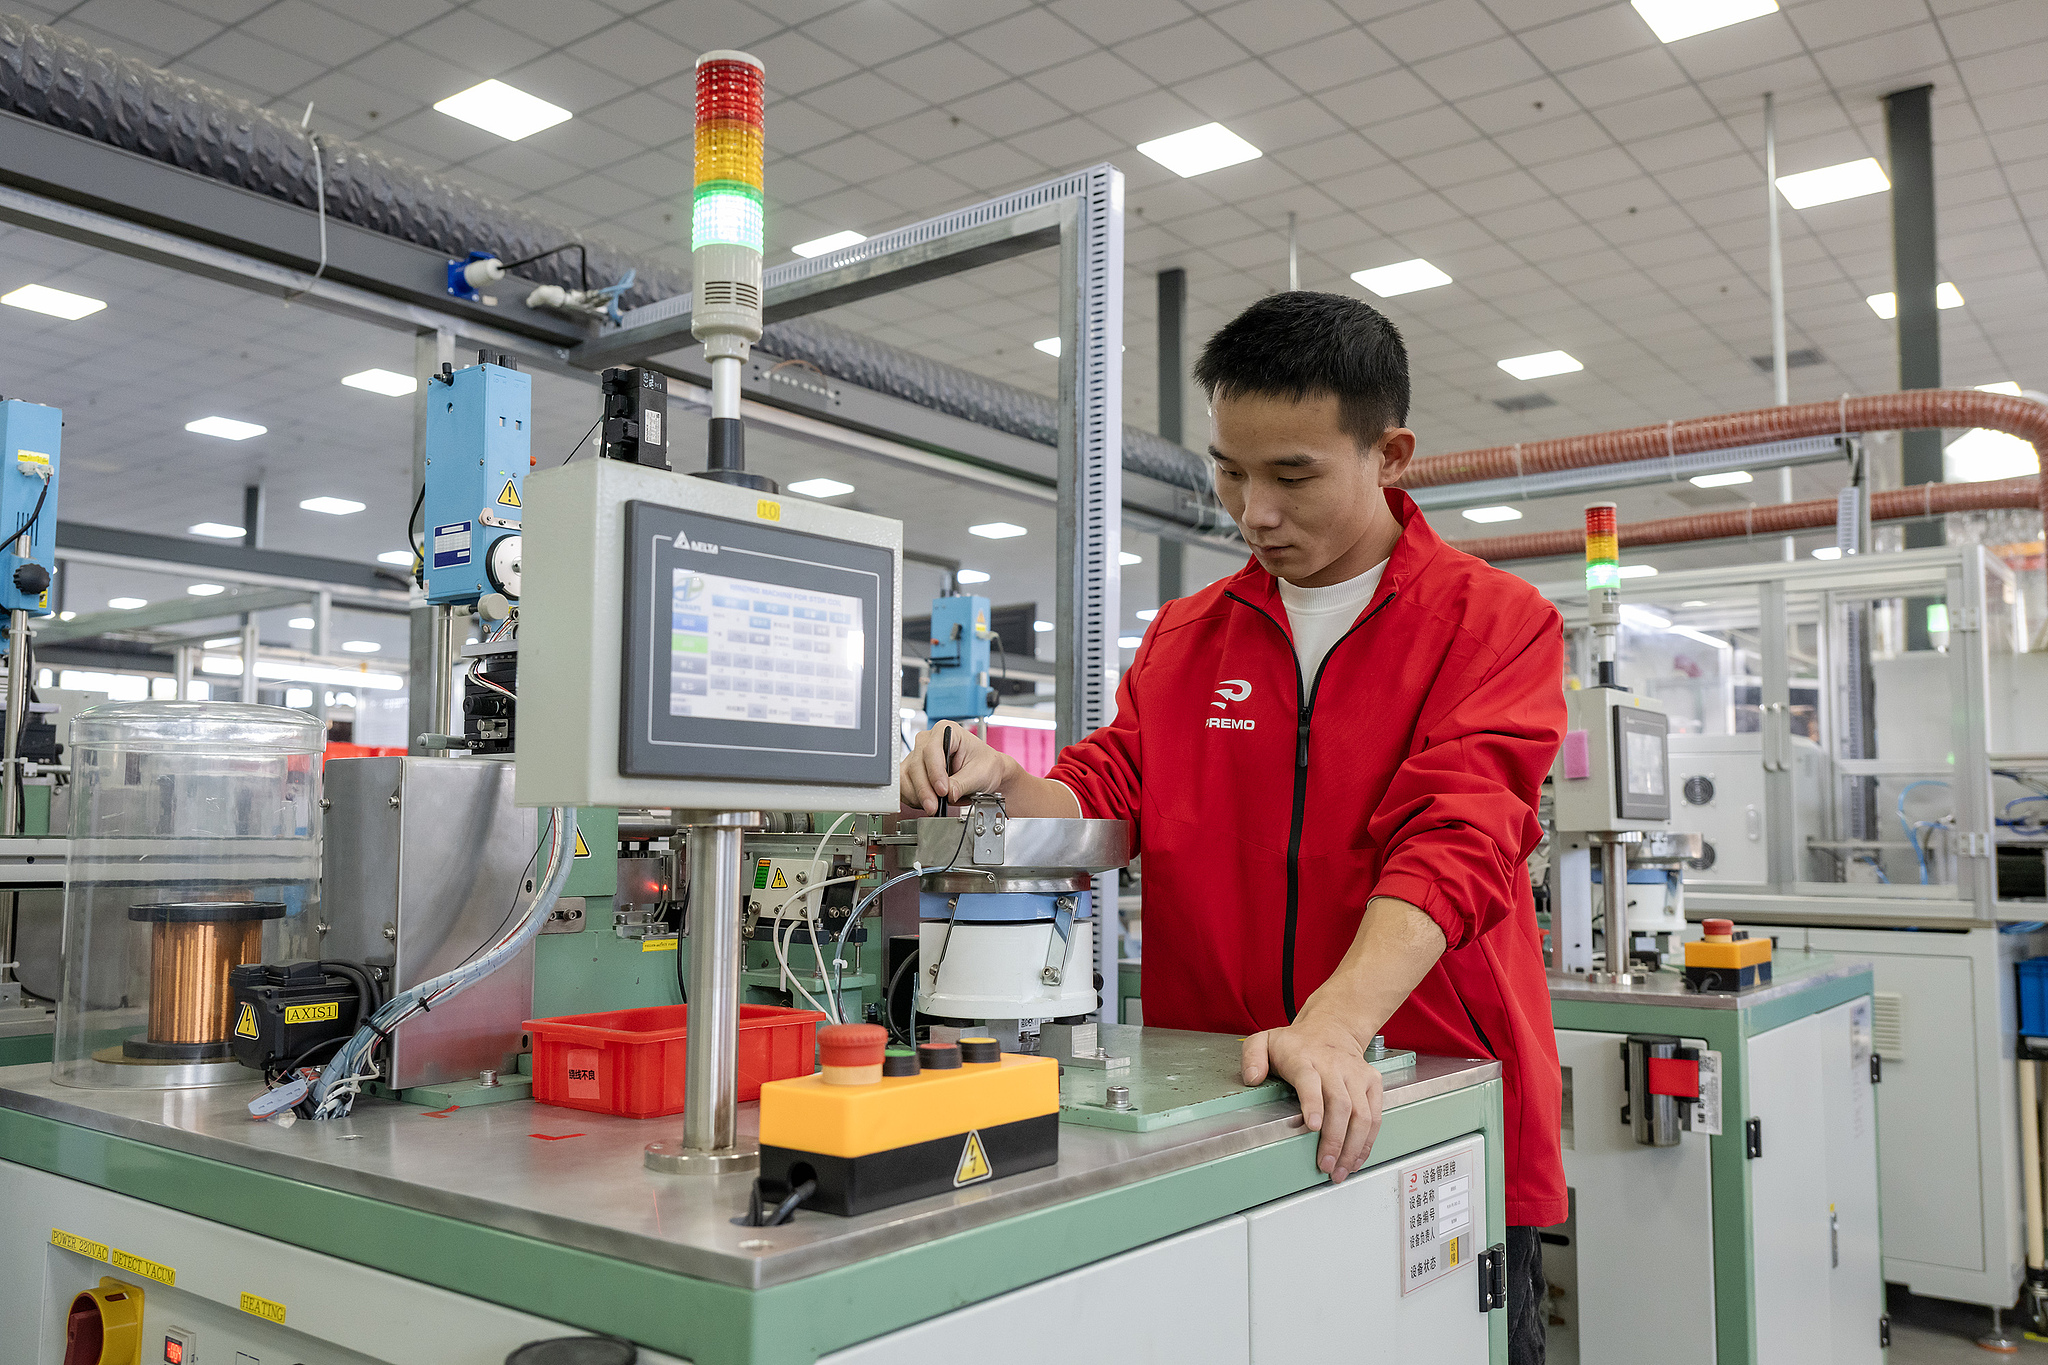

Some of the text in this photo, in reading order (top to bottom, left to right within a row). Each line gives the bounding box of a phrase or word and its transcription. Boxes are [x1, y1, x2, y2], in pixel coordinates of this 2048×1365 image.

[1205, 718, 1255, 730] REMO
[291, 1007, 332, 1020] AXIS1
[1409, 1189, 1435, 1209] 设备名称
[1409, 1208, 1435, 1229] 设备编号
[52, 1229, 109, 1262] POWER 220VAC
[1409, 1226, 1435, 1249] 设备负责人
[113, 1250, 175, 1285] DETECT VACUM
[1410, 1256, 1436, 1278] 设备状态
[241, 1293, 285, 1322] HEATING
